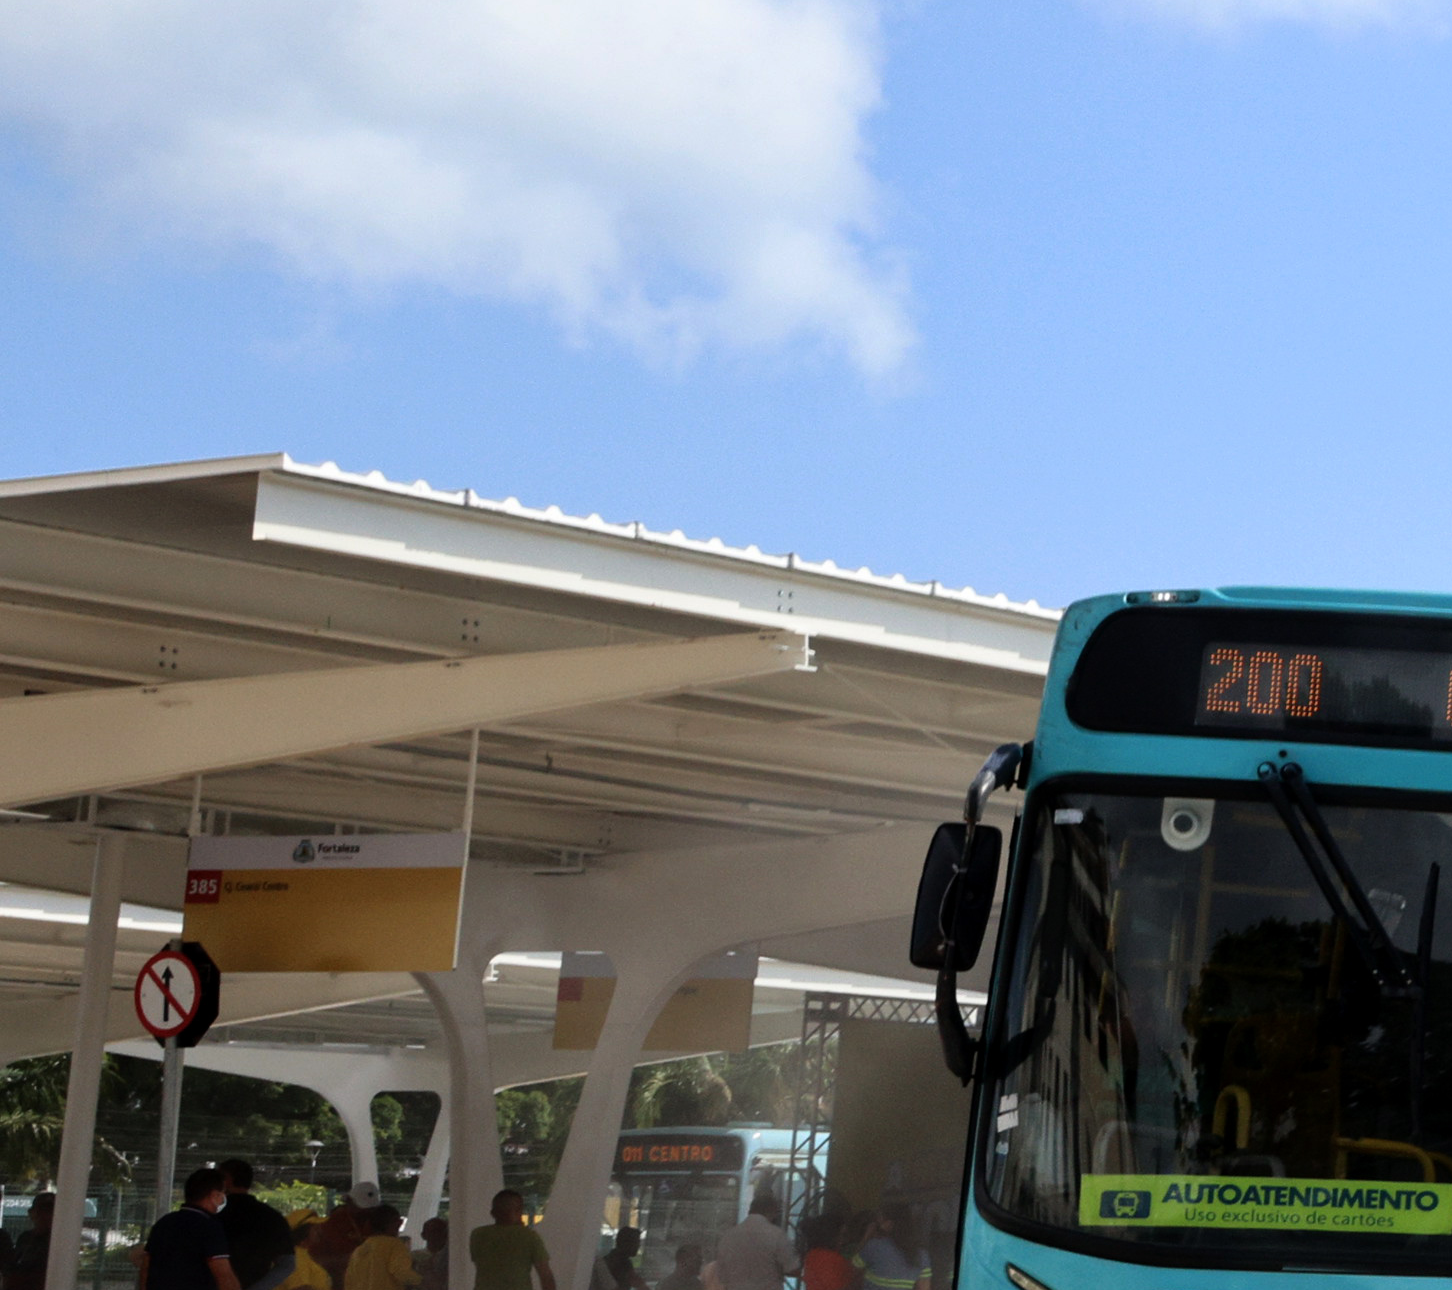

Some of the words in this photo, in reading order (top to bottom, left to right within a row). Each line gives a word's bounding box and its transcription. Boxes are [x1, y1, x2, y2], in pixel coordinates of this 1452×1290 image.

[1205, 647, 1324, 717] 200
[189, 879, 217, 895] 385
[649, 1145, 713, 1162] CENTRO
[1161, 1182, 1440, 1212] AUTOATENDIMENTO
[1184, 1207, 1215, 1222] Uso
[1221, 1209, 1301, 1226] exclusivo
[1305, 1211, 1328, 1226] de
[1331, 1211, 1395, 1228] cartões
